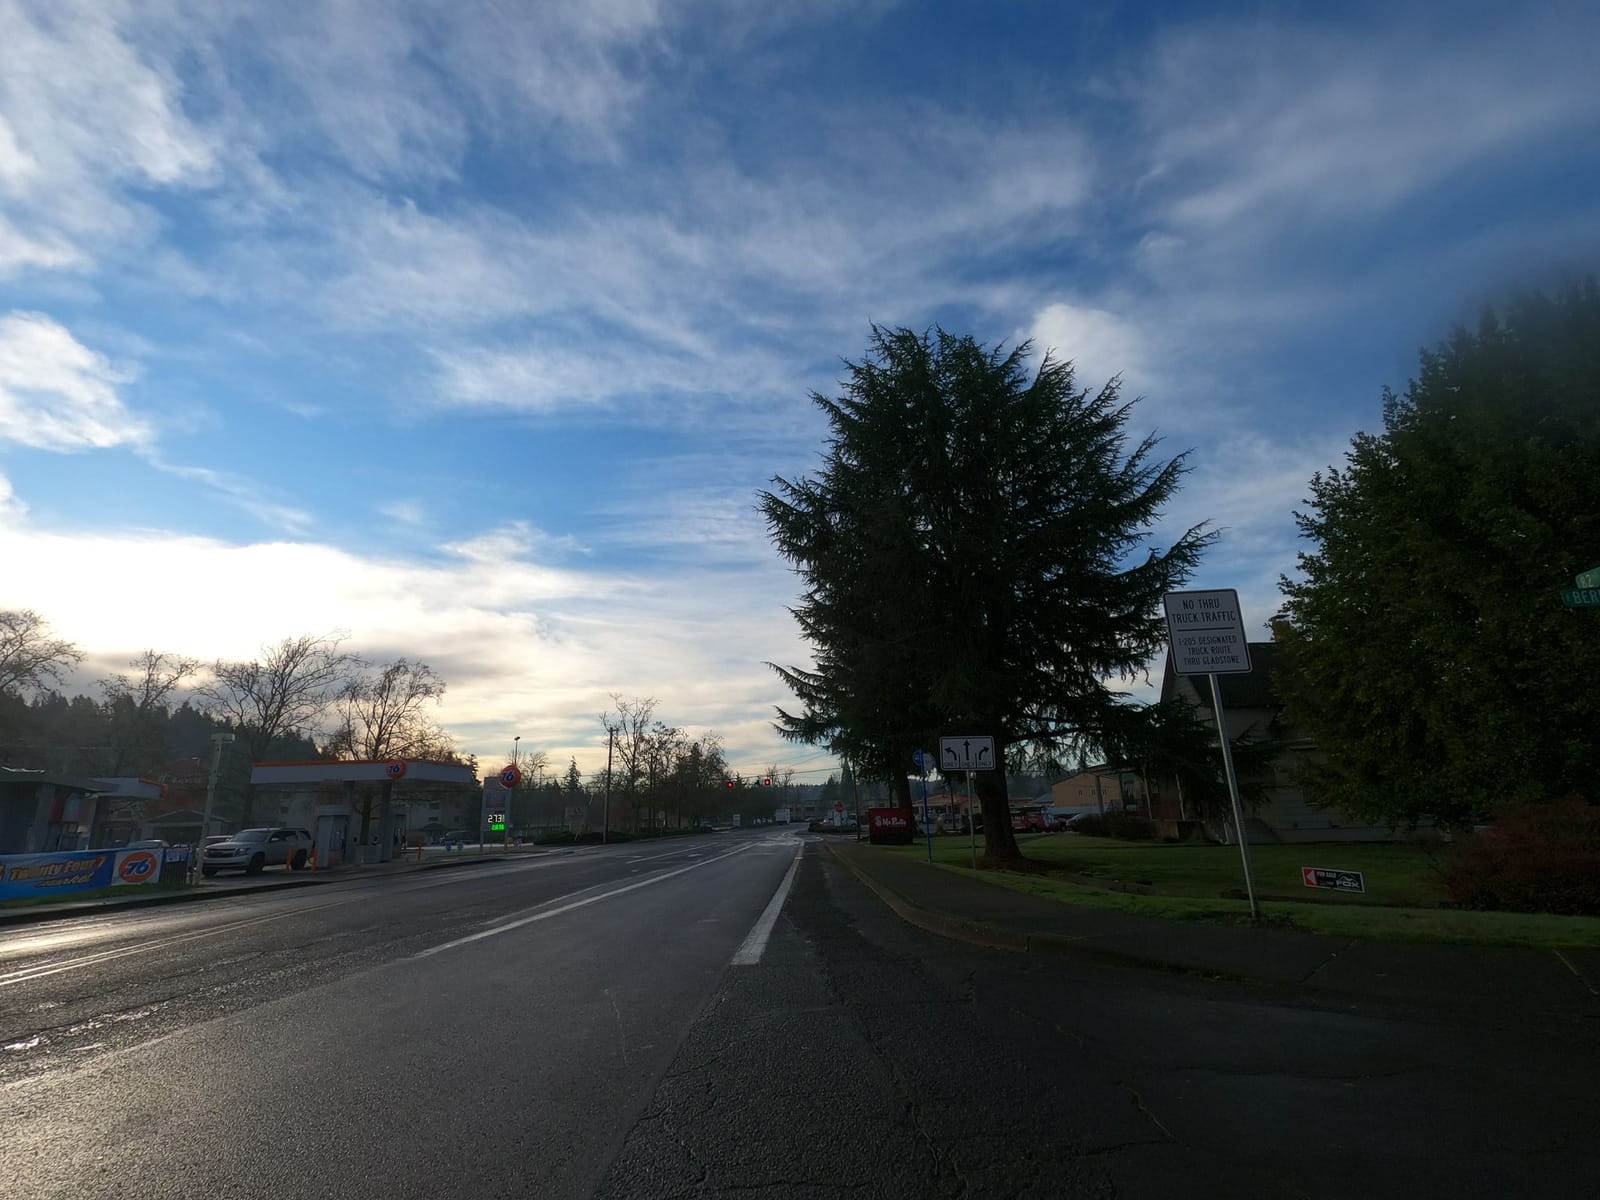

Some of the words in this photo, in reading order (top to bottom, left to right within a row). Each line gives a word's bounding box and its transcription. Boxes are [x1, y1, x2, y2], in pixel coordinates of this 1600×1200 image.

[1182, 600, 1194, 610] NO
[1198, 598, 1220, 609] THRU
[1171, 612, 1199, 624] TRUCK
[1200, 610, 1236, 622] TRAFFIC
[1198, 635, 1237, 645] DESIGNATED
[1188, 646, 1208, 655] TRUCK
[1211, 645, 1232, 654] ROUTE
[1184, 657, 1200, 665] THRU
[1203, 655, 1240, 665] GLADSTONE
[126, 858, 153, 876] 76
[1336, 880, 1360, 888] FOX
